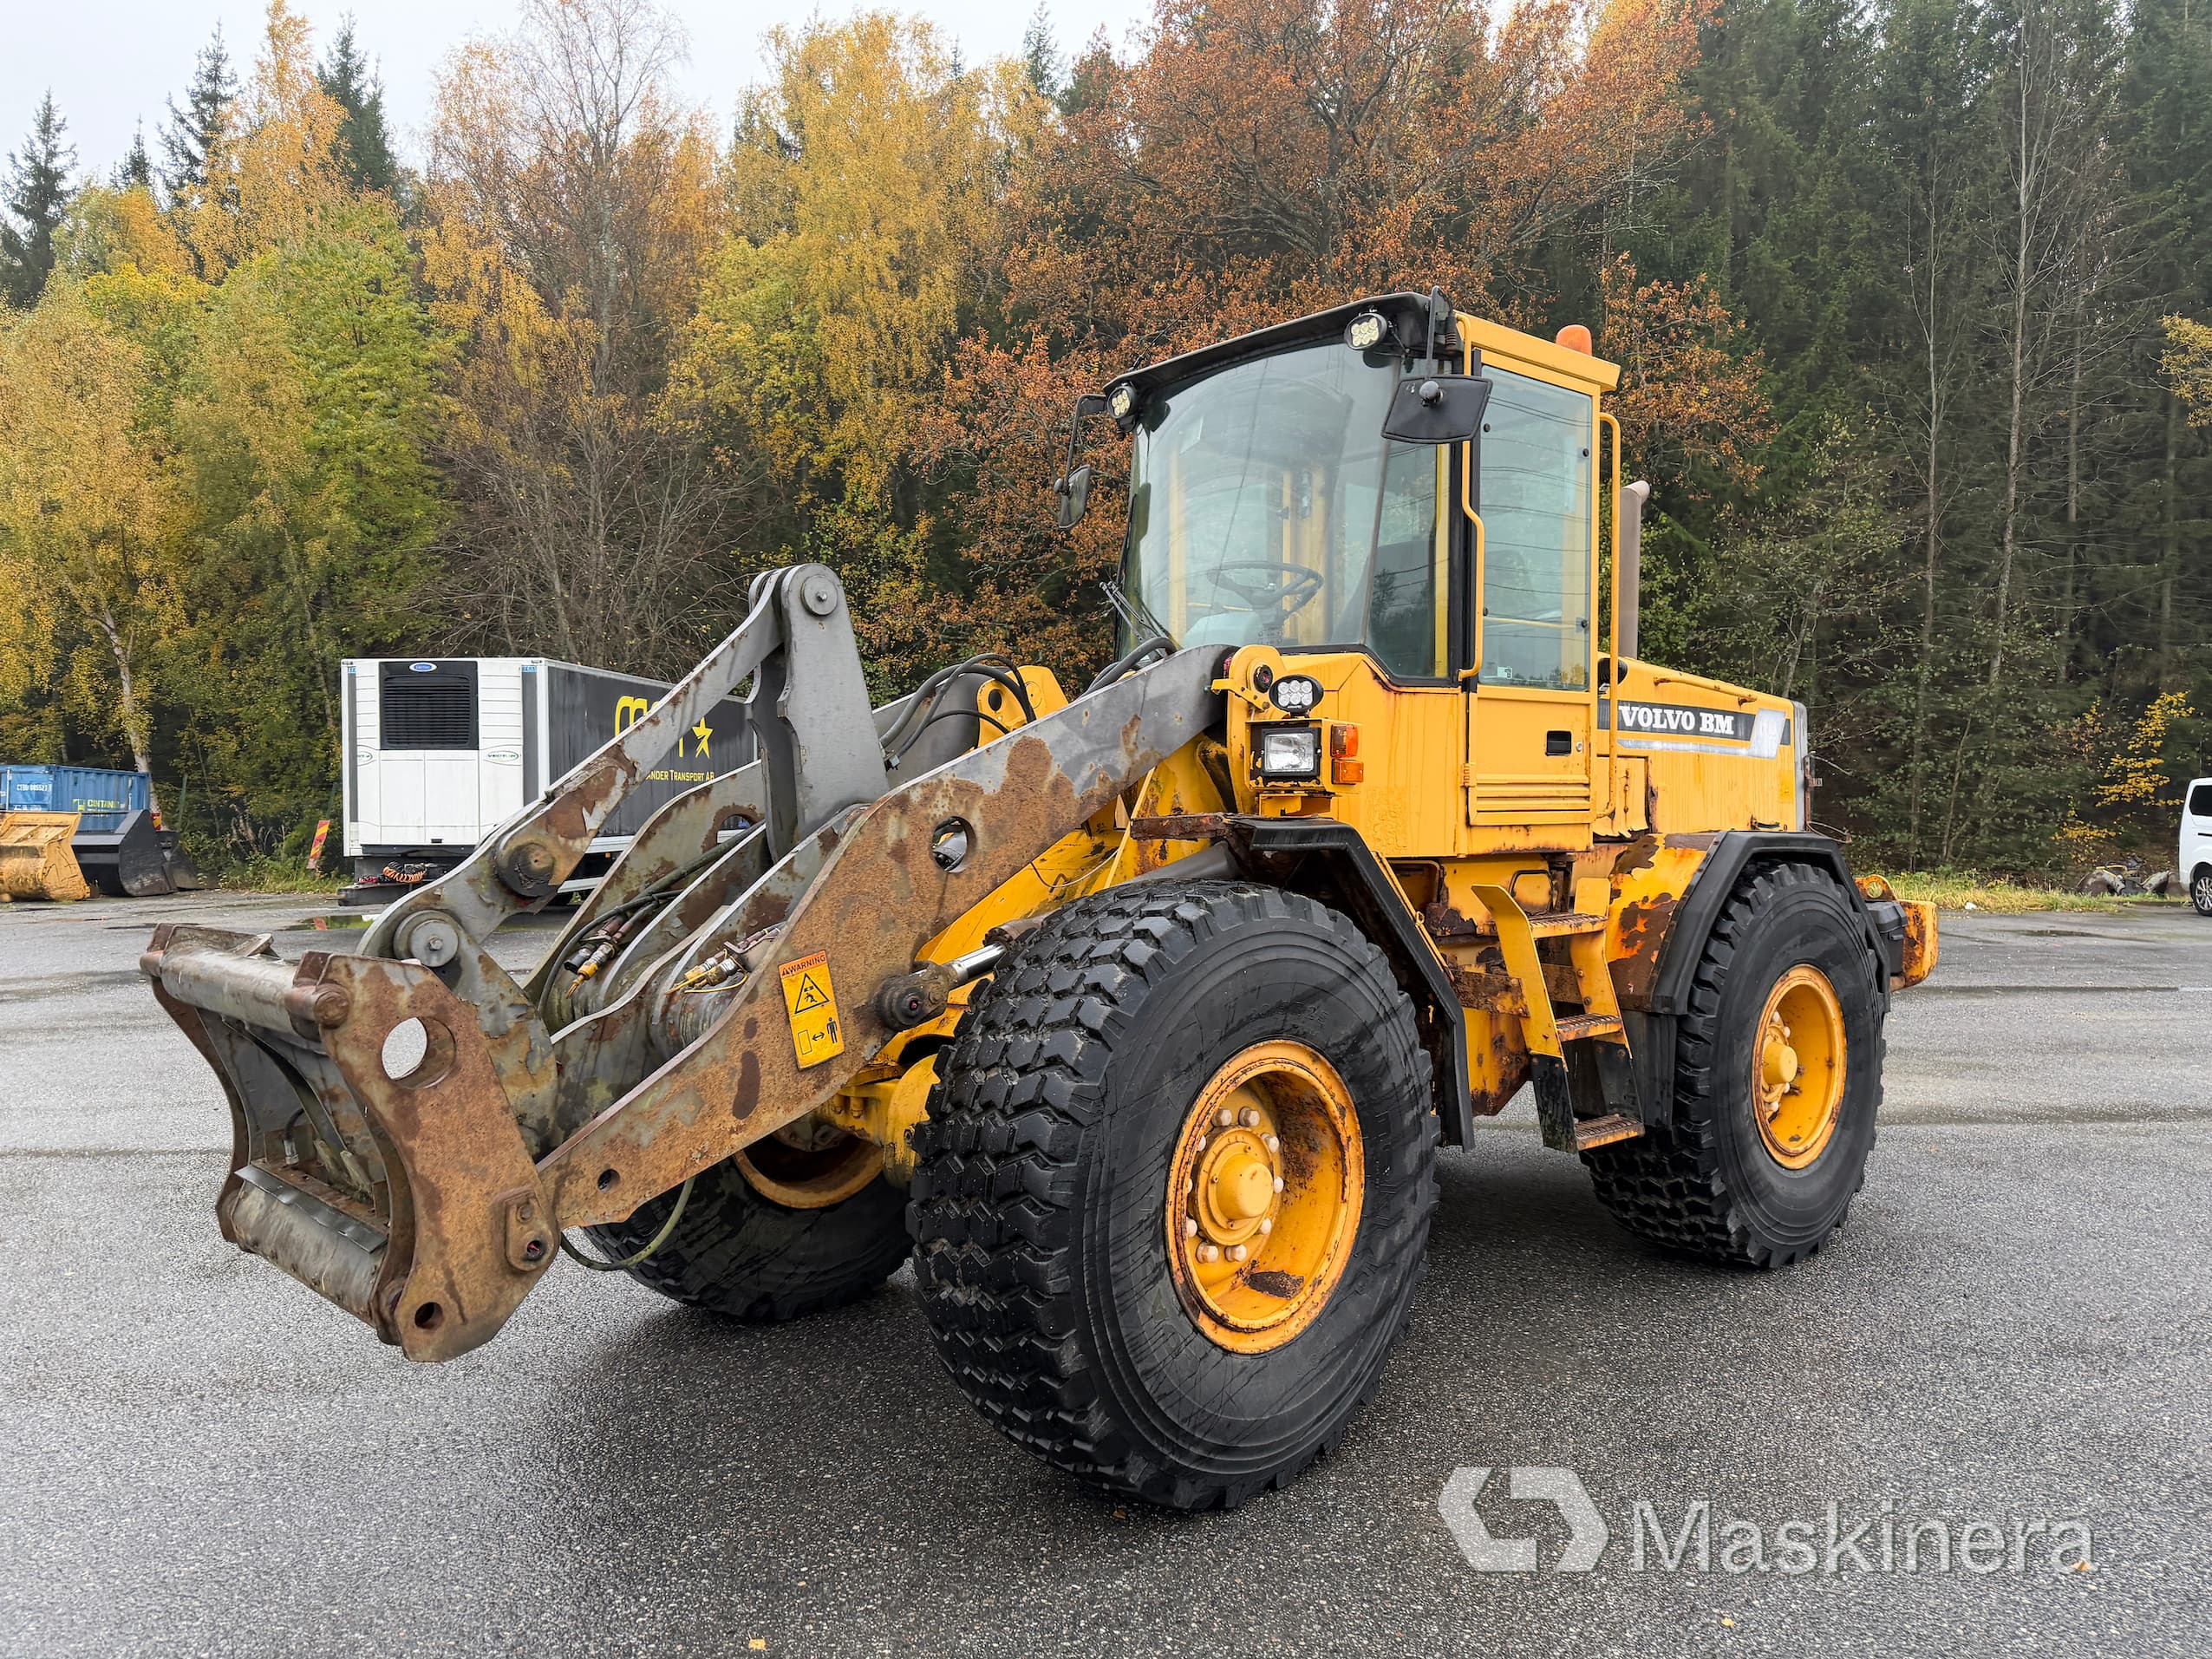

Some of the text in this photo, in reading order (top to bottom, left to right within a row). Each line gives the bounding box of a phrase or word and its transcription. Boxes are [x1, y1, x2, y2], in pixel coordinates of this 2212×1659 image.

[1618, 704, 1735, 735] VOLVO BM
[788, 955, 825, 973] WARNING
